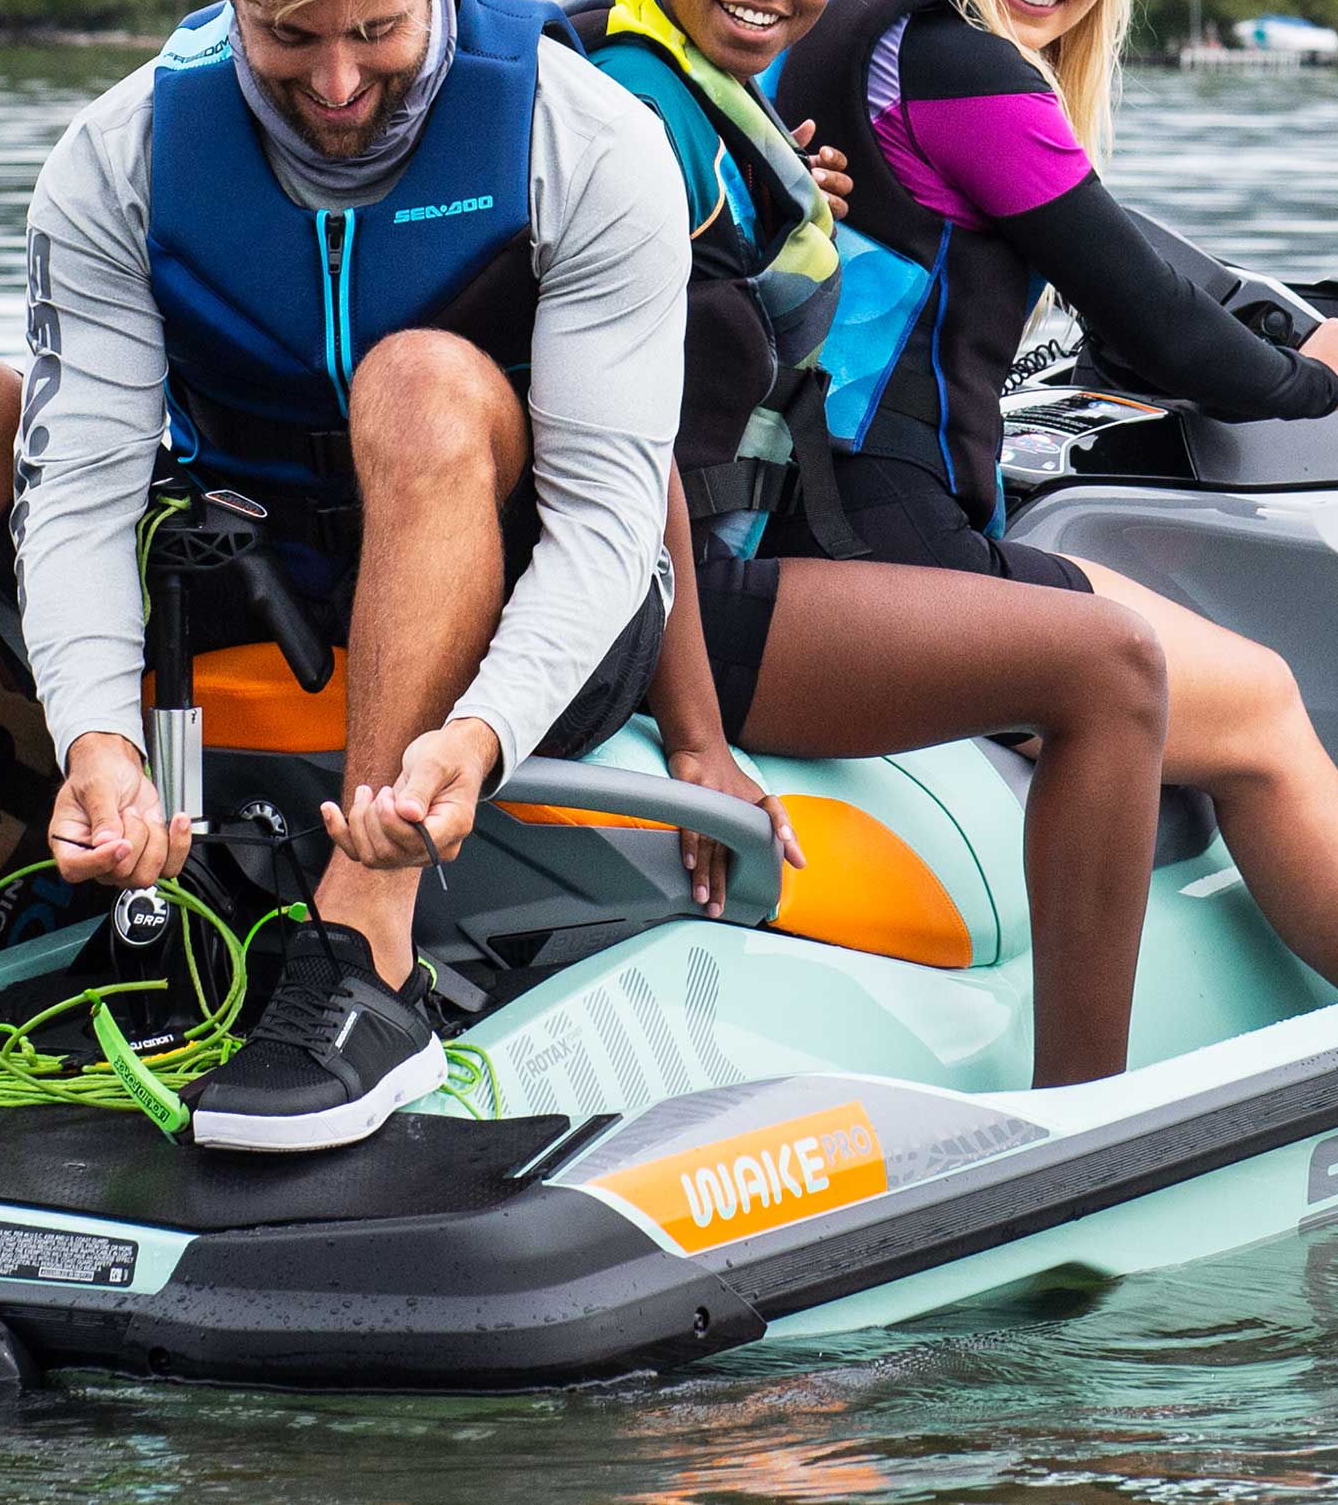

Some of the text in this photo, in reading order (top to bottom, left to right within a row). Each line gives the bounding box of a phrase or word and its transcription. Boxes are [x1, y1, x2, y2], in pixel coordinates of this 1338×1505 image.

[133, 913, 166, 927] BRP
[526, 1037, 573, 1078] ROTAX
[681, 1125, 872, 1228] WAKE PRO
